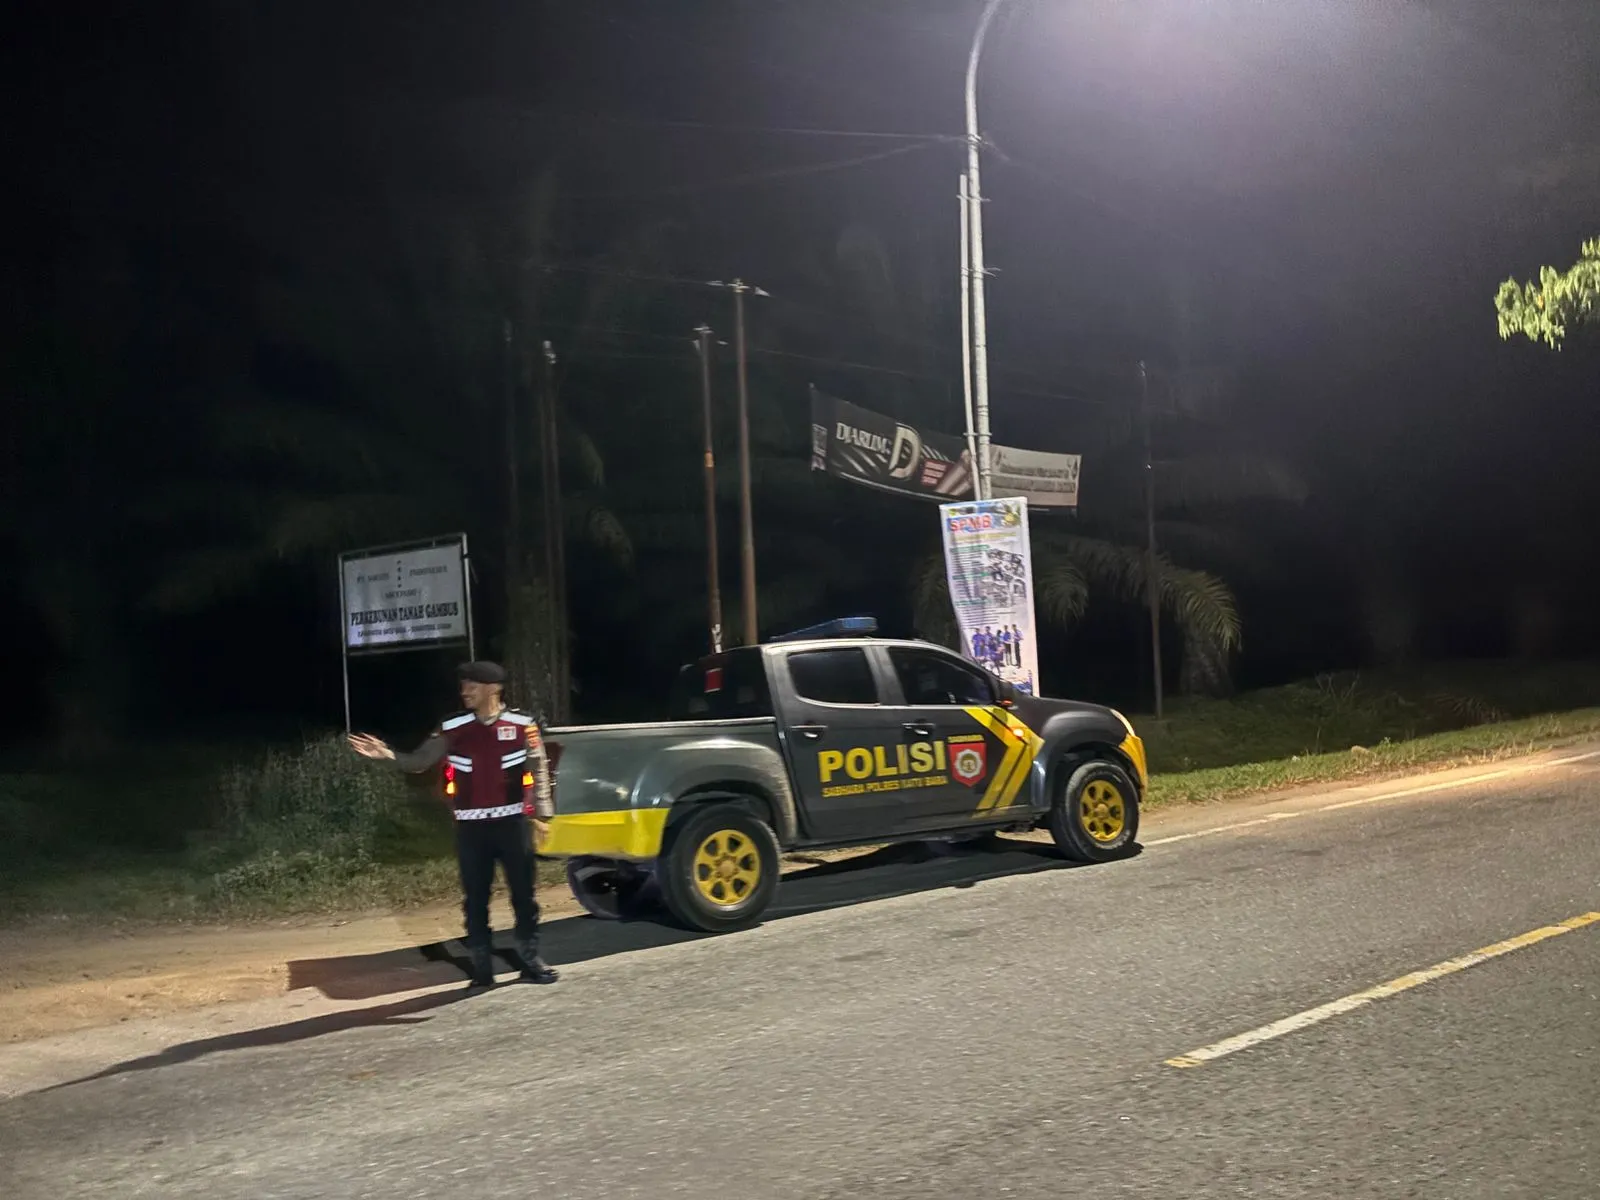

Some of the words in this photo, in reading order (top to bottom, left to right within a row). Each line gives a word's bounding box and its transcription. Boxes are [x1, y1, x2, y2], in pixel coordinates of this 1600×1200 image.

[350, 610, 398, 626] PERKEBUNAN
[399, 604, 424, 621] TANAH
[425, 602, 459, 618] GAMBUS
[818, 740, 947, 783] POLISI
